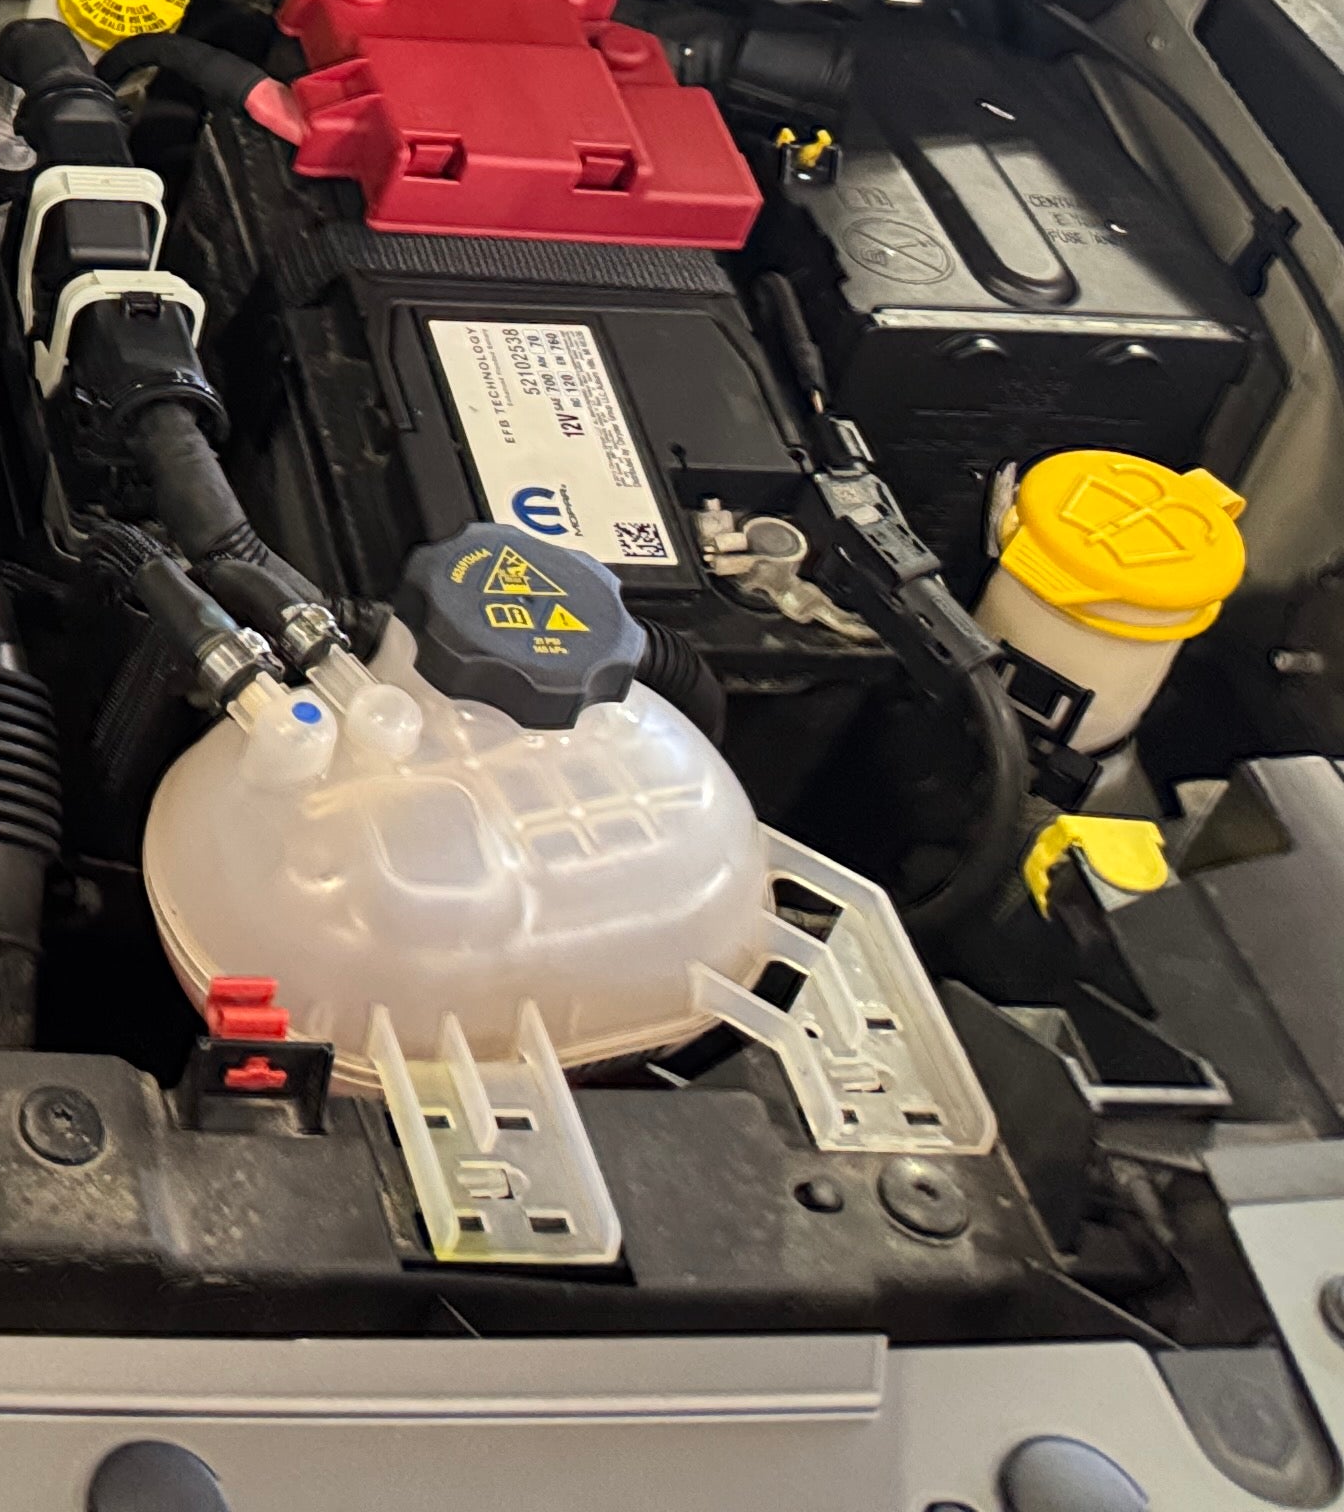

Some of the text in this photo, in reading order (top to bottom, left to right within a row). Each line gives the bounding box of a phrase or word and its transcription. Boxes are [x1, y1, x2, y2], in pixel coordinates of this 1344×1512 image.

[527, 335, 542, 348] 70
[546, 333, 564, 351] 760
[502, 328, 541, 396] 52102538
[466, 327, 515, 444] EFB TECHNOLOGY
[543, 374, 559, 393] 700
[561, 375, 578, 393] 120
[557, 413, 585, 437] 12V
